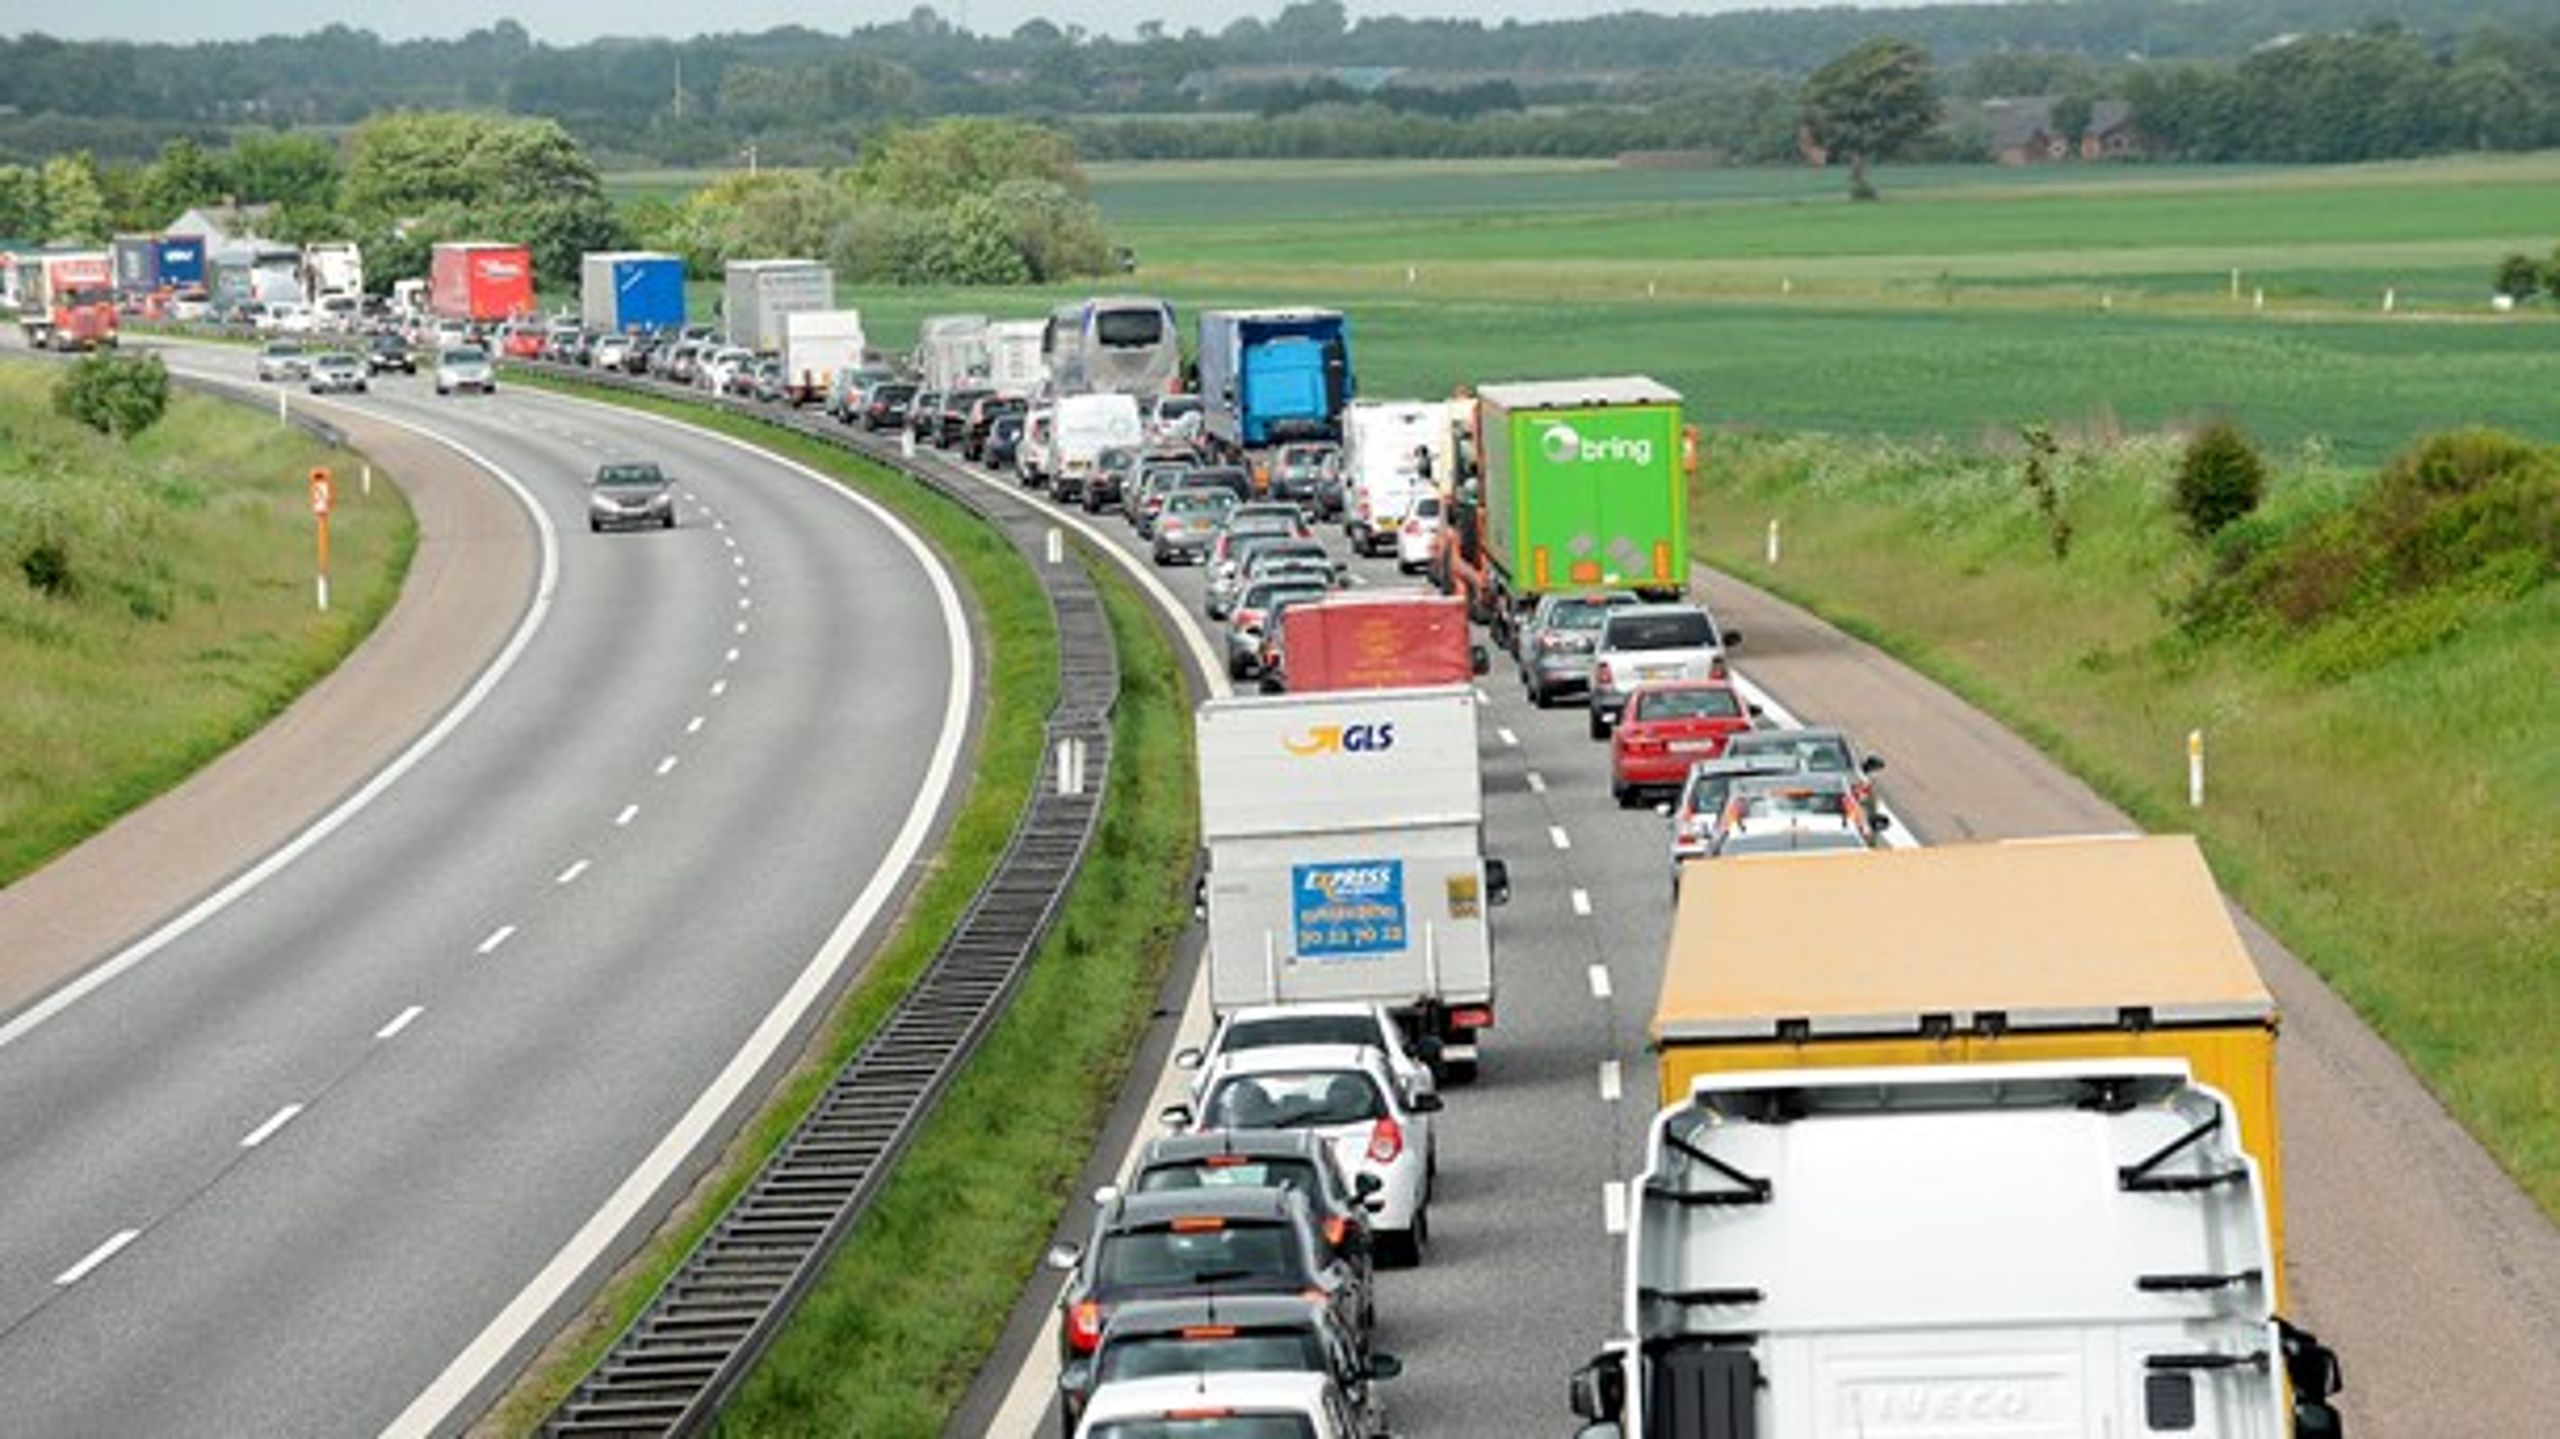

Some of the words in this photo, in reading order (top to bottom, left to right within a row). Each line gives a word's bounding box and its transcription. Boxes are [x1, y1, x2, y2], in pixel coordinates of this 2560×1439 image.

[1581, 436, 1652, 466] bring
[1343, 723, 1395, 752] GLS
[1879, 1386, 2031, 1422] IVECO
